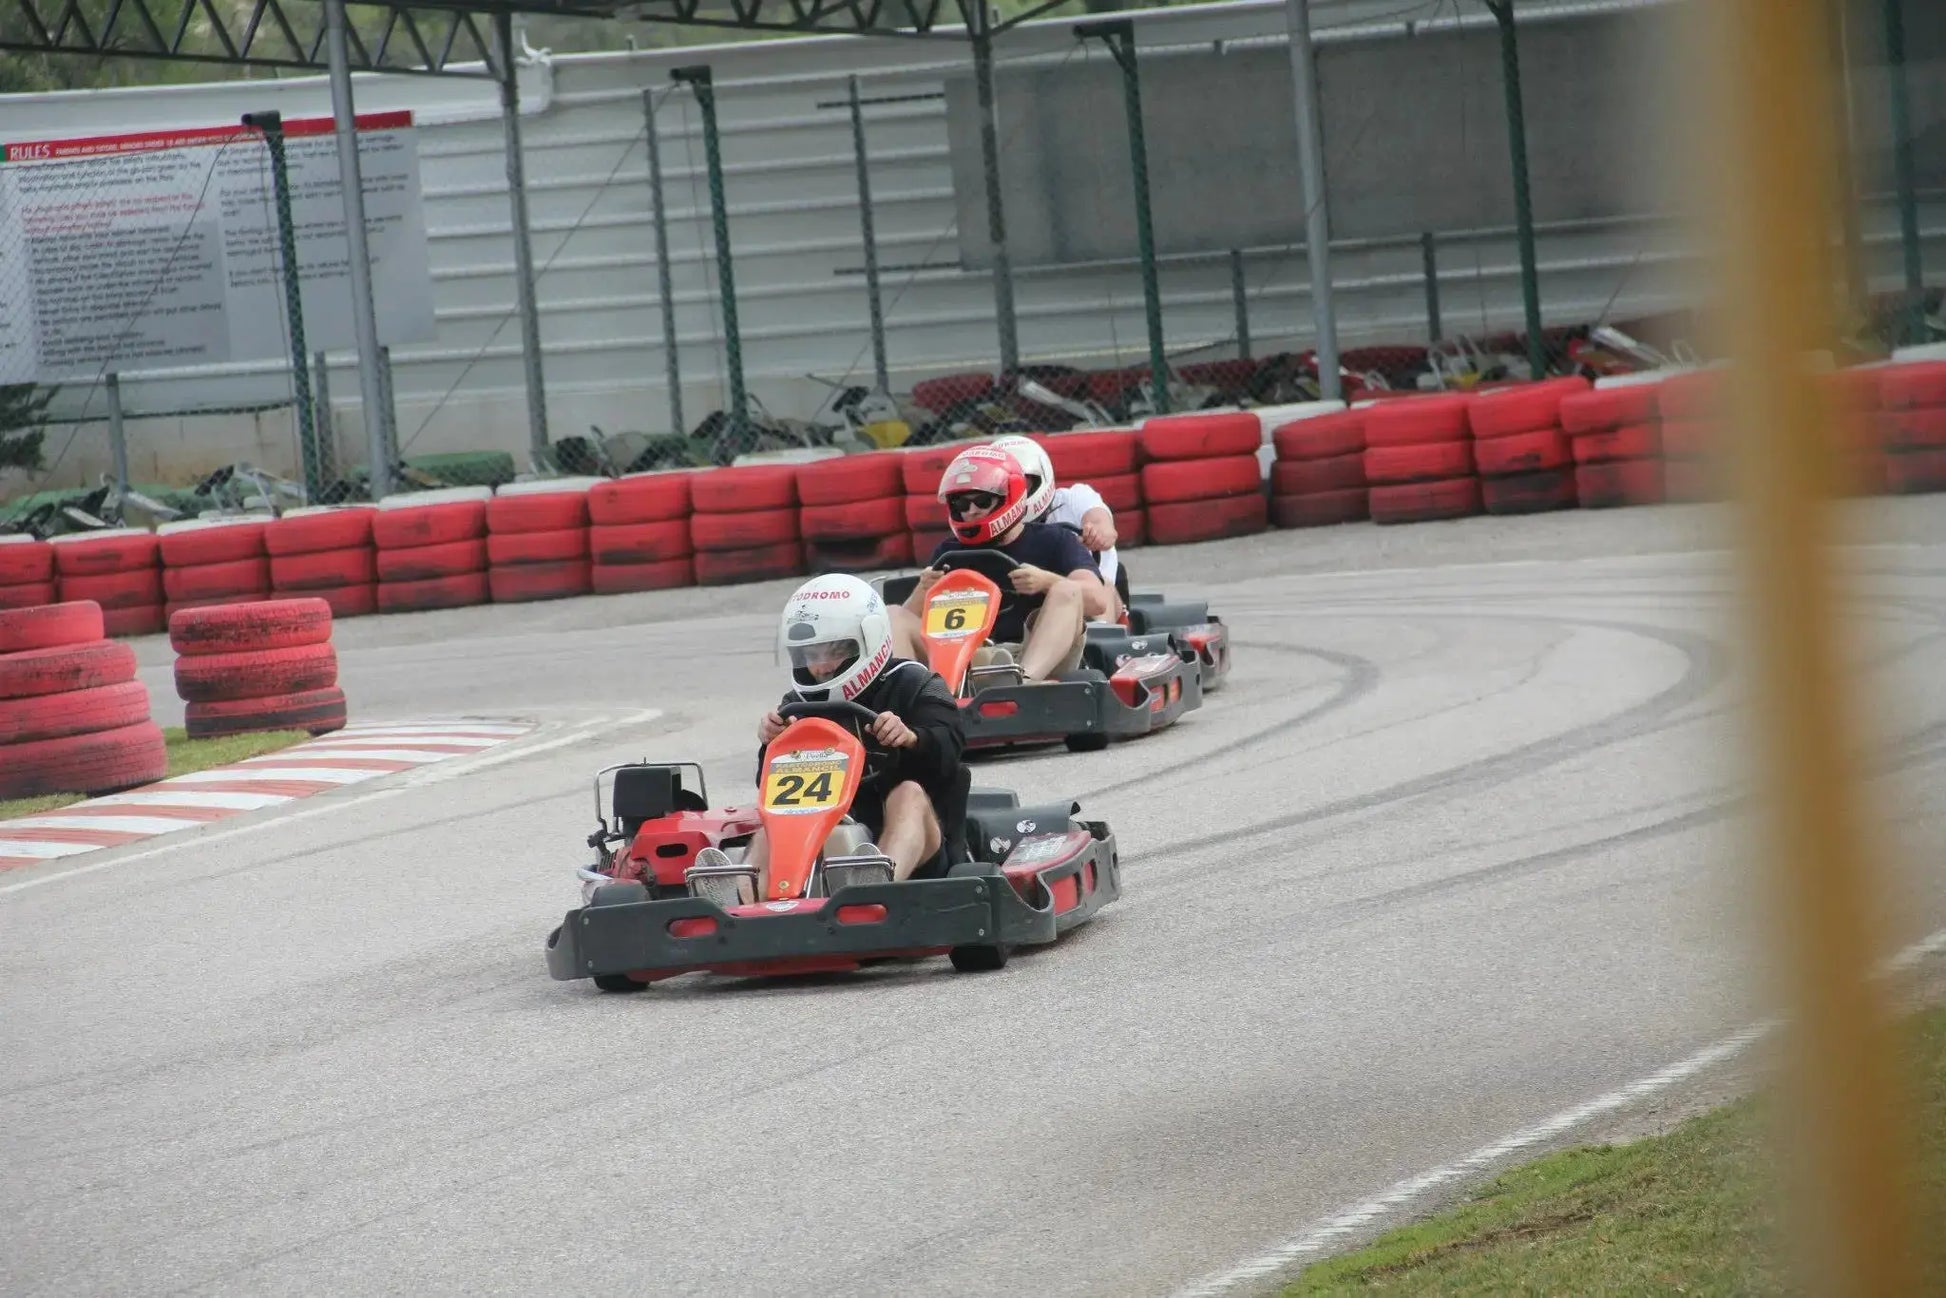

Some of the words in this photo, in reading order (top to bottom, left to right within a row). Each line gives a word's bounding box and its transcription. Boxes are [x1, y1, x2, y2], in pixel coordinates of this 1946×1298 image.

[10, 144, 50, 160] RULES
[793, 591, 850, 601] ODROMO
[944, 608, 966, 630] 6
[772, 772, 832, 806] 24
